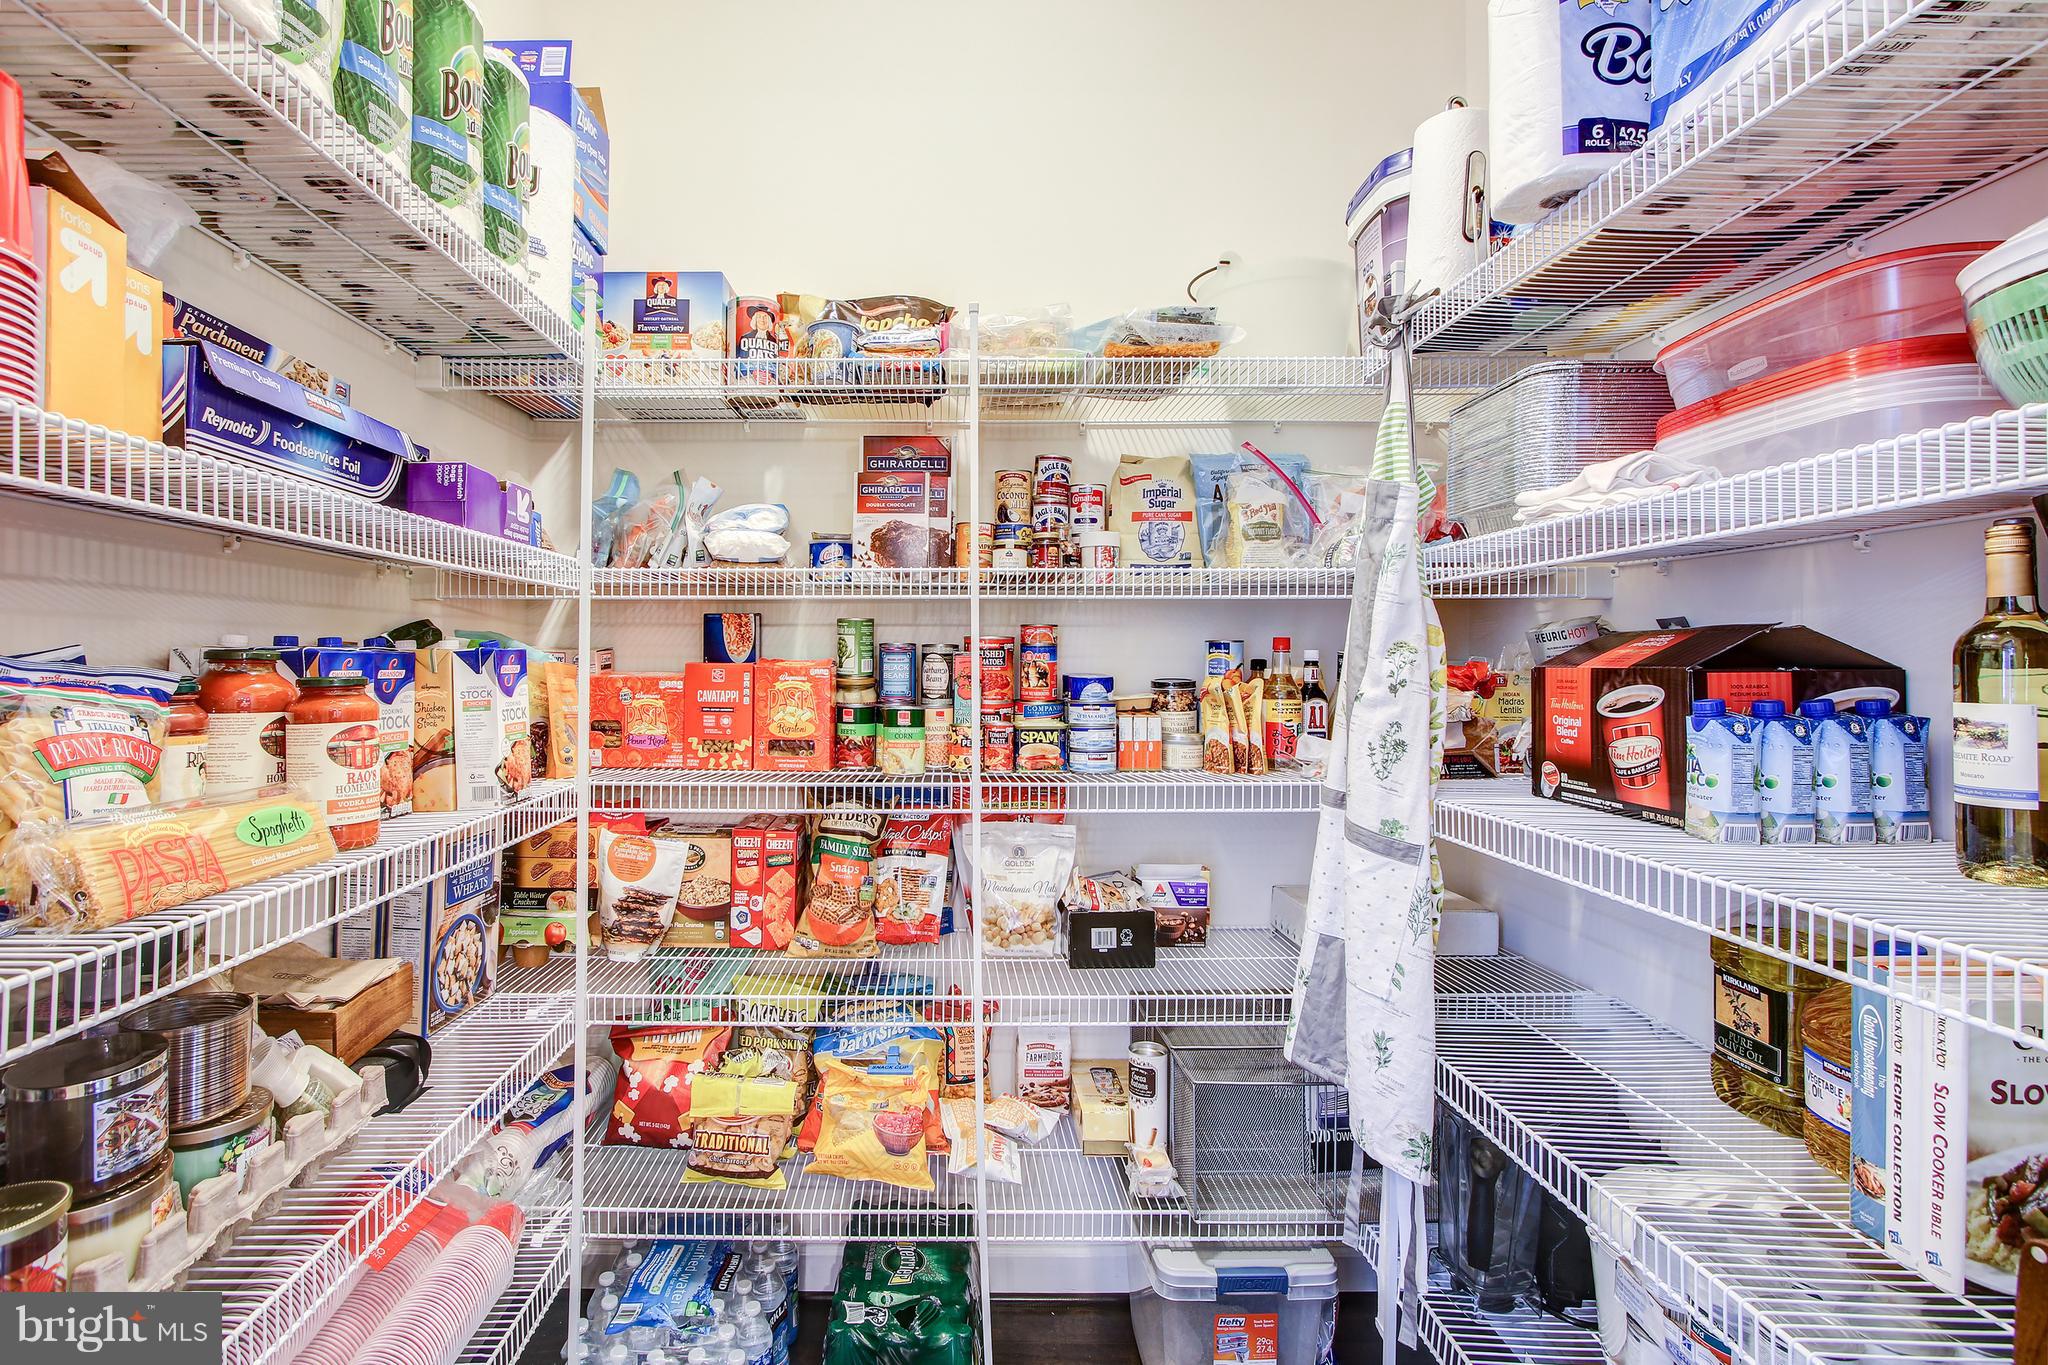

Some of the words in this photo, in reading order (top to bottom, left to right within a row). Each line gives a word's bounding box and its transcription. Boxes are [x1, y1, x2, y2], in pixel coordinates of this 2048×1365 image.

[1592, 124, 1604, 139] 6
[1619, 126, 1647, 144] 425
[1585, 138, 1610, 147] ROLLS
[59, 205, 92, 236] forks
[647, 298, 676, 307] QUAKER
[187, 307, 229, 330] GENUINE
[638, 324, 659, 332] Flavor
[660, 324, 684, 333] Variety
[180, 312, 266, 364] Parchment
[211, 351, 252, 379] Premium
[251, 370, 282, 393] Quality
[1730, 361, 1765, 379] Rubbermaid
[202, 407, 258, 439] Reynolds
[273, 433, 340, 469] Foodservice
[342, 455, 361, 475] Foil
[869, 457, 946, 470] GHIRARDELLI
[861, 484, 921, 496] GHIRARDELLI
[1142, 488, 1181, 500] Imperial
[1148, 498, 1176, 511] Sugar
[1535, 629, 1568, 645] KEURIG
[1567, 628, 1588, 641] HOT
[883, 672, 910, 680] BEANS
[460, 689, 493, 700] STOCK
[697, 690, 739, 703] CAVATAPPI
[414, 702, 447, 713] Chicken
[1498, 698, 1525, 707] Madras
[502, 707, 527, 722] STOCK
[1308, 705, 1326, 729] A1
[1500, 706, 1524, 715] Lentils
[88, 722, 126, 733] ITALIAN
[380, 715, 410, 730] TOCK
[417, 718, 438, 729] Stock
[1552, 714, 1582, 728] Original
[894, 732, 913, 740] CORN
[1020, 731, 1059, 745] SPAM
[1556, 725, 1578, 738] Blend
[1560, 737, 1575, 745] Coffee
[48, 736, 108, 767] PENNE
[112, 736, 159, 771] RIGATE
[1981, 752, 2011, 763] ROAD
[69, 764, 112, 777] AUTHENTIC
[347, 769, 377, 785] RAO'S
[249, 811, 306, 846] Spaghetti
[734, 837, 761, 848] CHEEZ-IT
[766, 839, 794, 850] CHEEZ-IT
[820, 839, 850, 855] FAMILY
[459, 874, 472, 883] BITE
[473, 867, 484, 879] SIZE
[830, 862, 860, 874] Snaps
[107, 834, 229, 920] PASTA
[453, 876, 489, 899] WHEATS
[980, 879, 1031, 894] Macadamia
[513, 891, 528, 900] Table
[528, 891, 547, 901] Water
[513, 898, 539, 907] Crackers
[508, 928, 539, 937] Applesauce
[1722, 973, 1760, 995] KIRKLAND
[1863, 1013, 1877, 1039] Good
[753, 1037, 779, 1049] PORK
[779, 1038, 808, 1051] SKINS
[839, 1033, 874, 1052] Party
[1728, 1031, 1753, 1049] PURE
[1025, 1051, 1063, 1062] FARMHOUSE
[1718, 1035, 1745, 1056] OLIVE
[1746, 1050, 1765, 1066] OIL
[2022, 1055, 2042, 1064] THE
[1860, 1039, 1876, 1100] Housekeeping
[1806, 1066, 1844, 1099] VEGETABLE
[1879, 1073, 1887, 1089] the
[1811, 1084, 1824, 1100] OIL
[1893, 1063, 1903, 1120] RECIPE
[1933, 1082, 1949, 1132] SLOW
[695, 1132, 769, 1154] TRADITIONAL
[708, 1154, 752, 1166] chicharrones
[1930, 1133, 1949, 1202] COOKER
[1892, 1123, 1903, 1222] COLLECTION
[1930, 1204, 1942, 1240] BIBLE
[719, 1254, 741, 1290] KIRKLAND
[671, 1272, 694, 1305] water
[1219, 1318, 1244, 1327] Hefty
[1256, 1345, 1275, 1353] 27.4L
